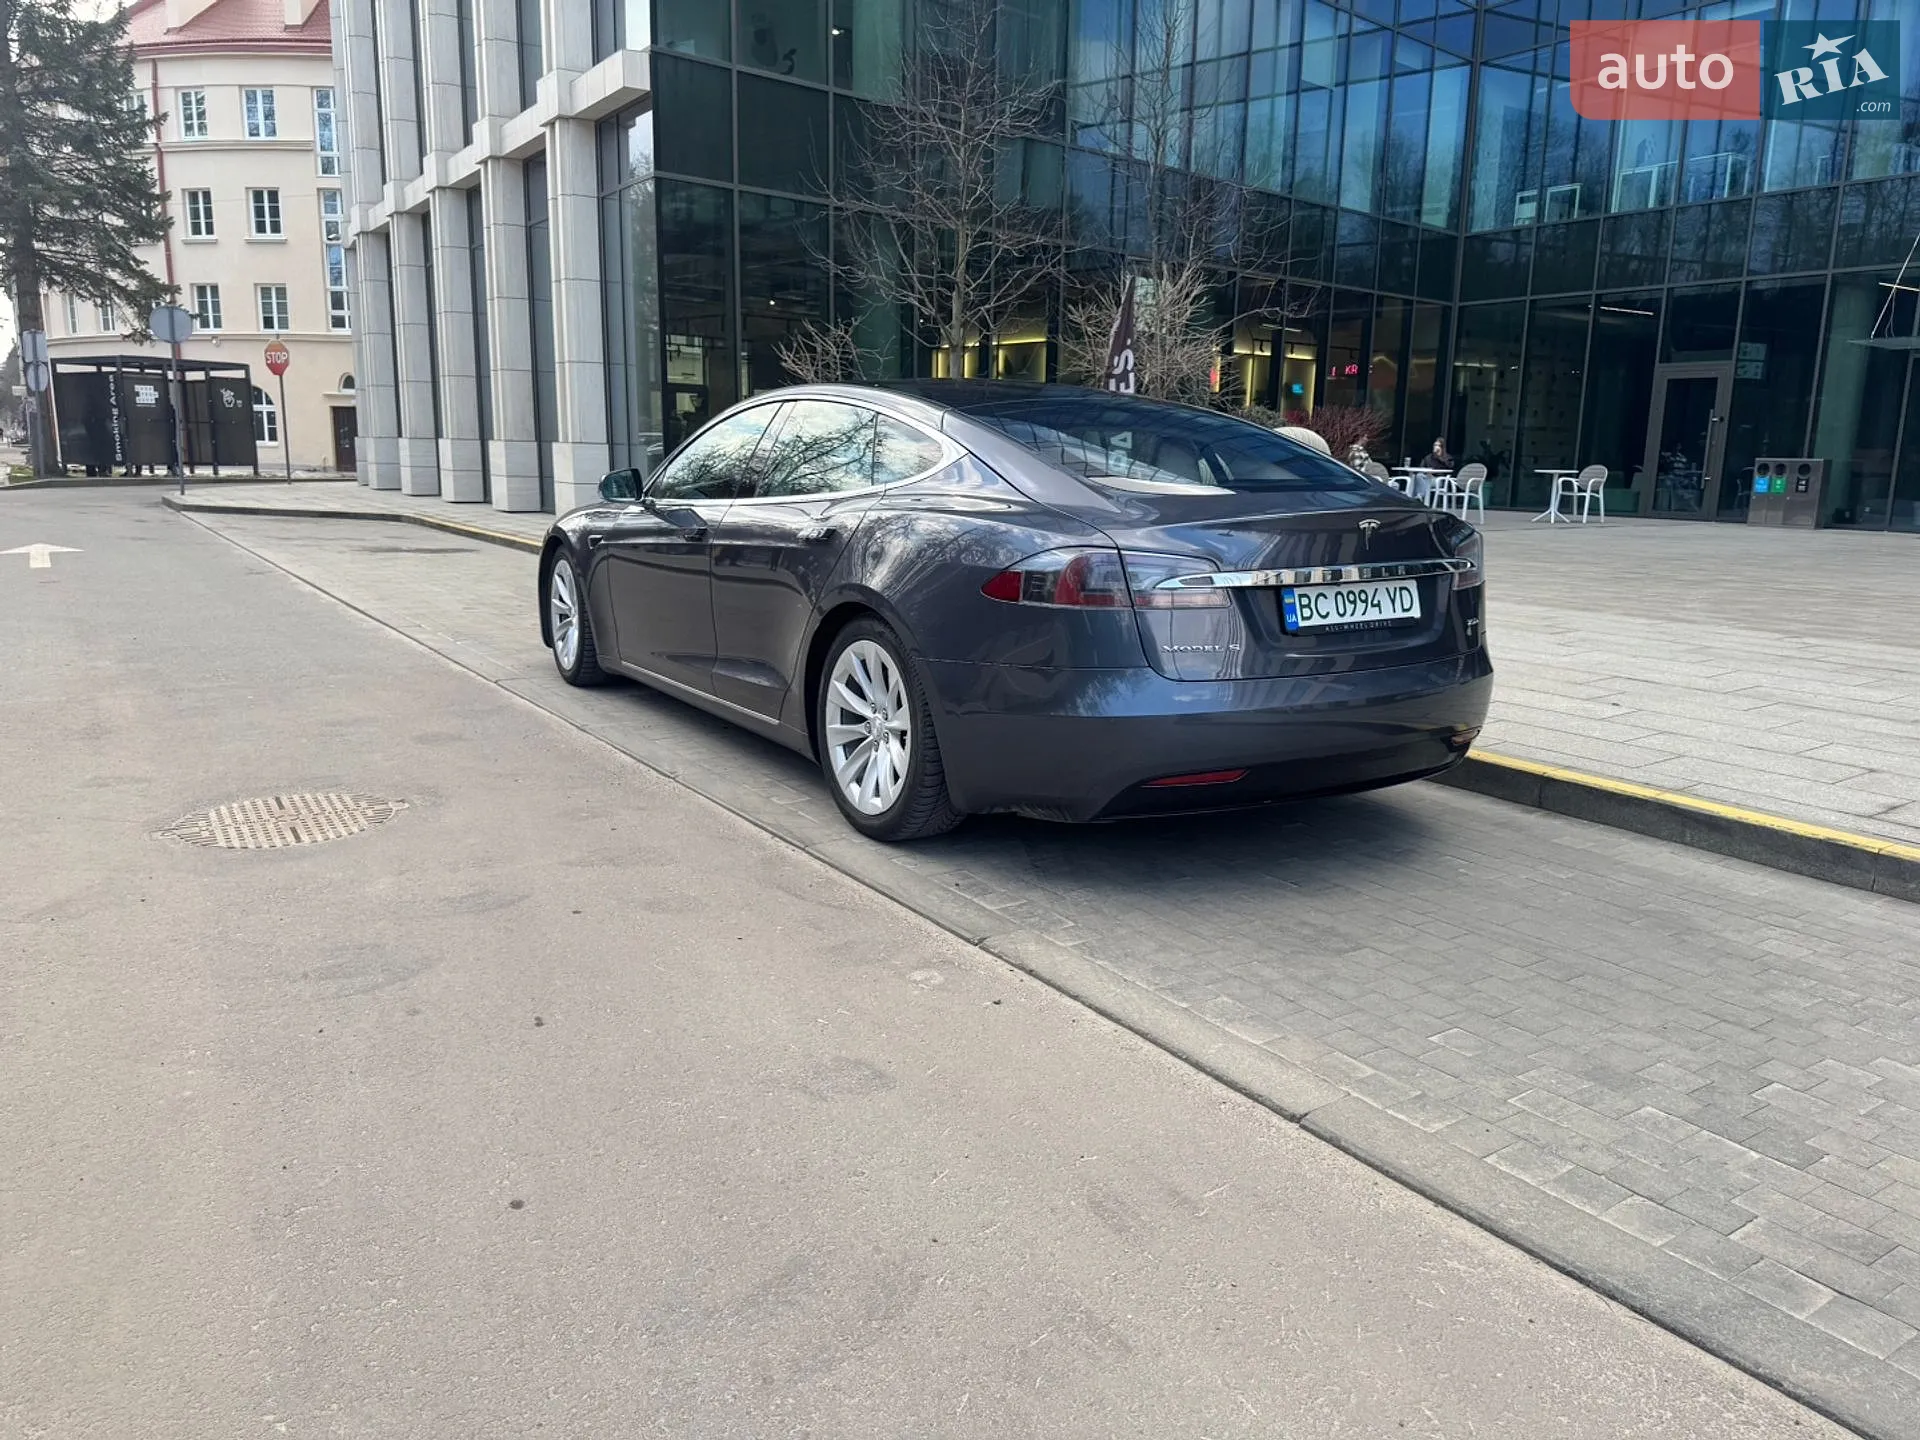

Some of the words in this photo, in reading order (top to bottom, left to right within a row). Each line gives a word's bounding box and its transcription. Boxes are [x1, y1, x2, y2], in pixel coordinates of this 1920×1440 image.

[266, 351, 288, 364] STOP
[108, 374, 118, 406] Area
[111, 408, 123, 461] Smoking
[1286, 612, 1298, 623] UA
[1298, 592, 1330, 622] BC
[1335, 588, 1383, 617] 0994
[1385, 586, 1414, 613] YD
